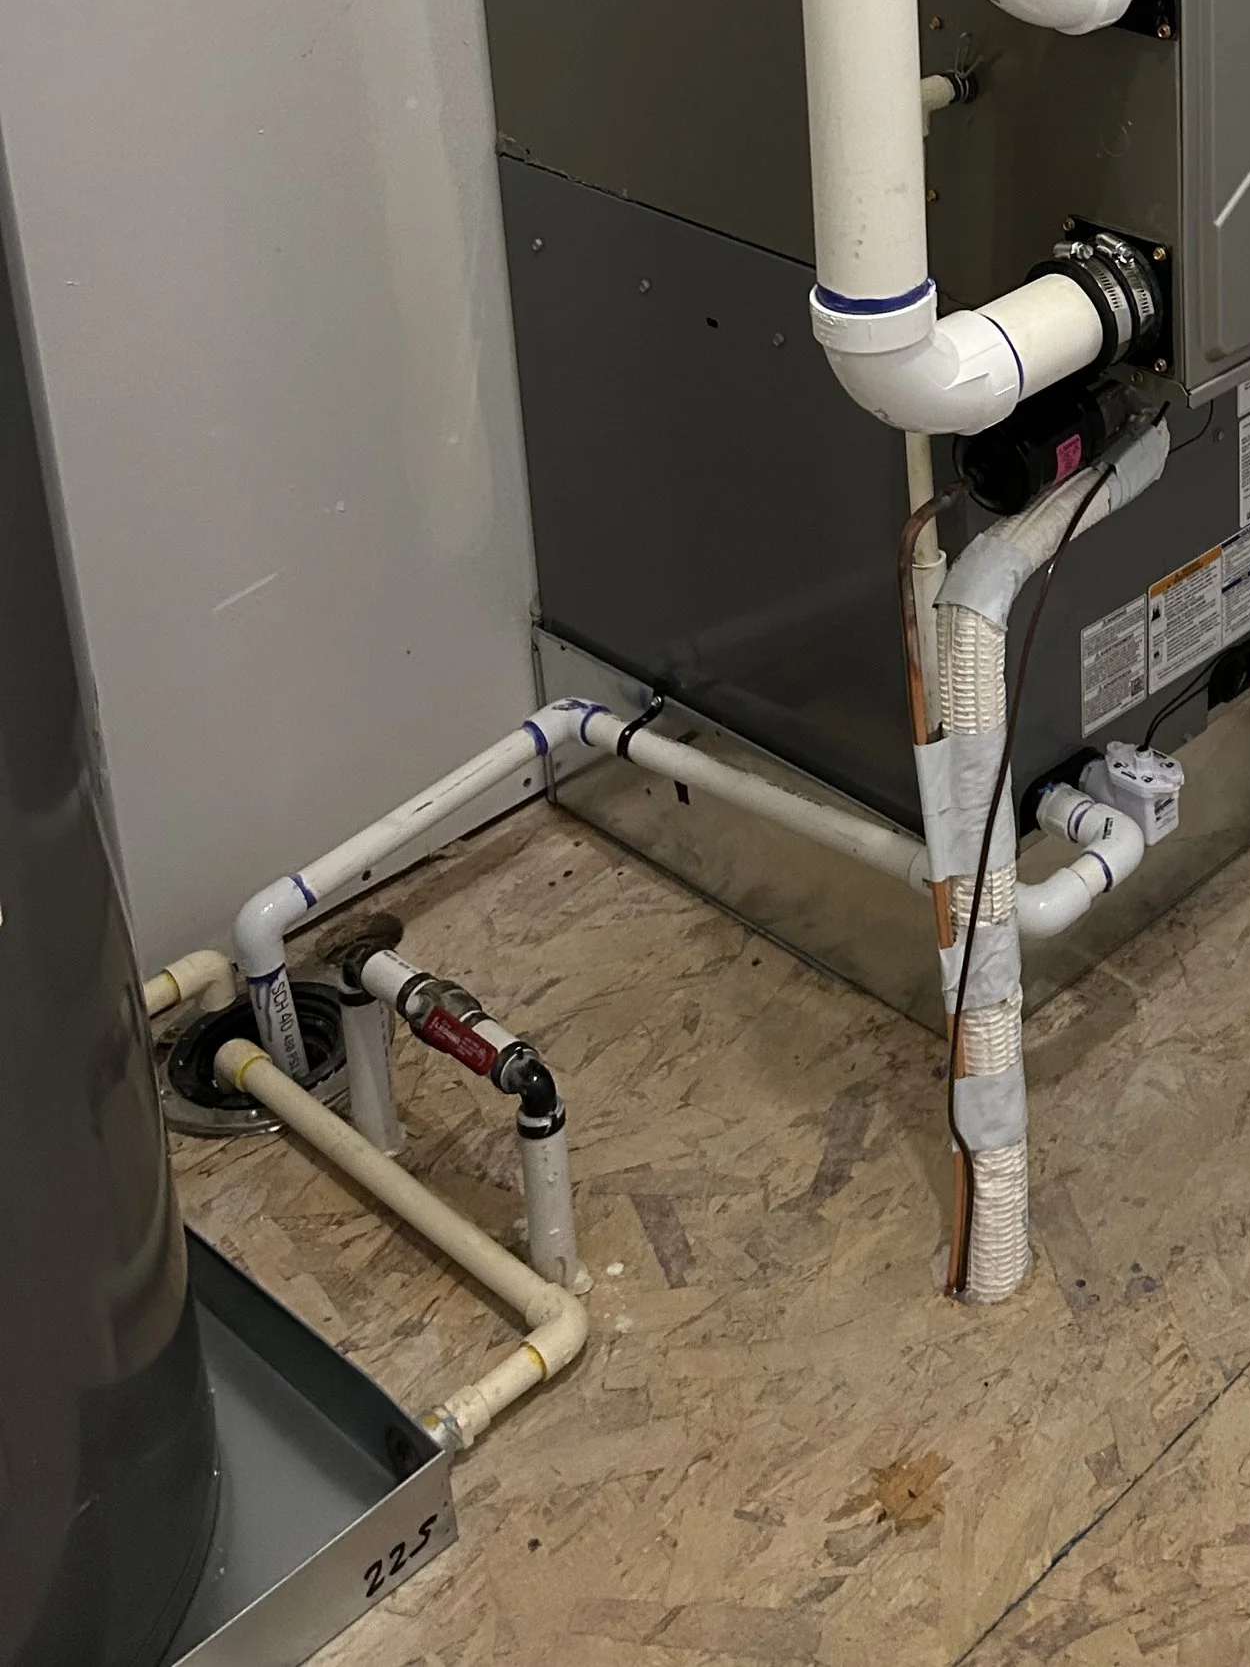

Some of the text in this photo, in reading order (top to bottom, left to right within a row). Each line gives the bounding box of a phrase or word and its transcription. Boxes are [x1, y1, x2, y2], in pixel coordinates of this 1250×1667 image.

[272, 981, 289, 1013] SCH
[279, 1014, 294, 1033] 40
[363, 1513, 438, 1599] 225
